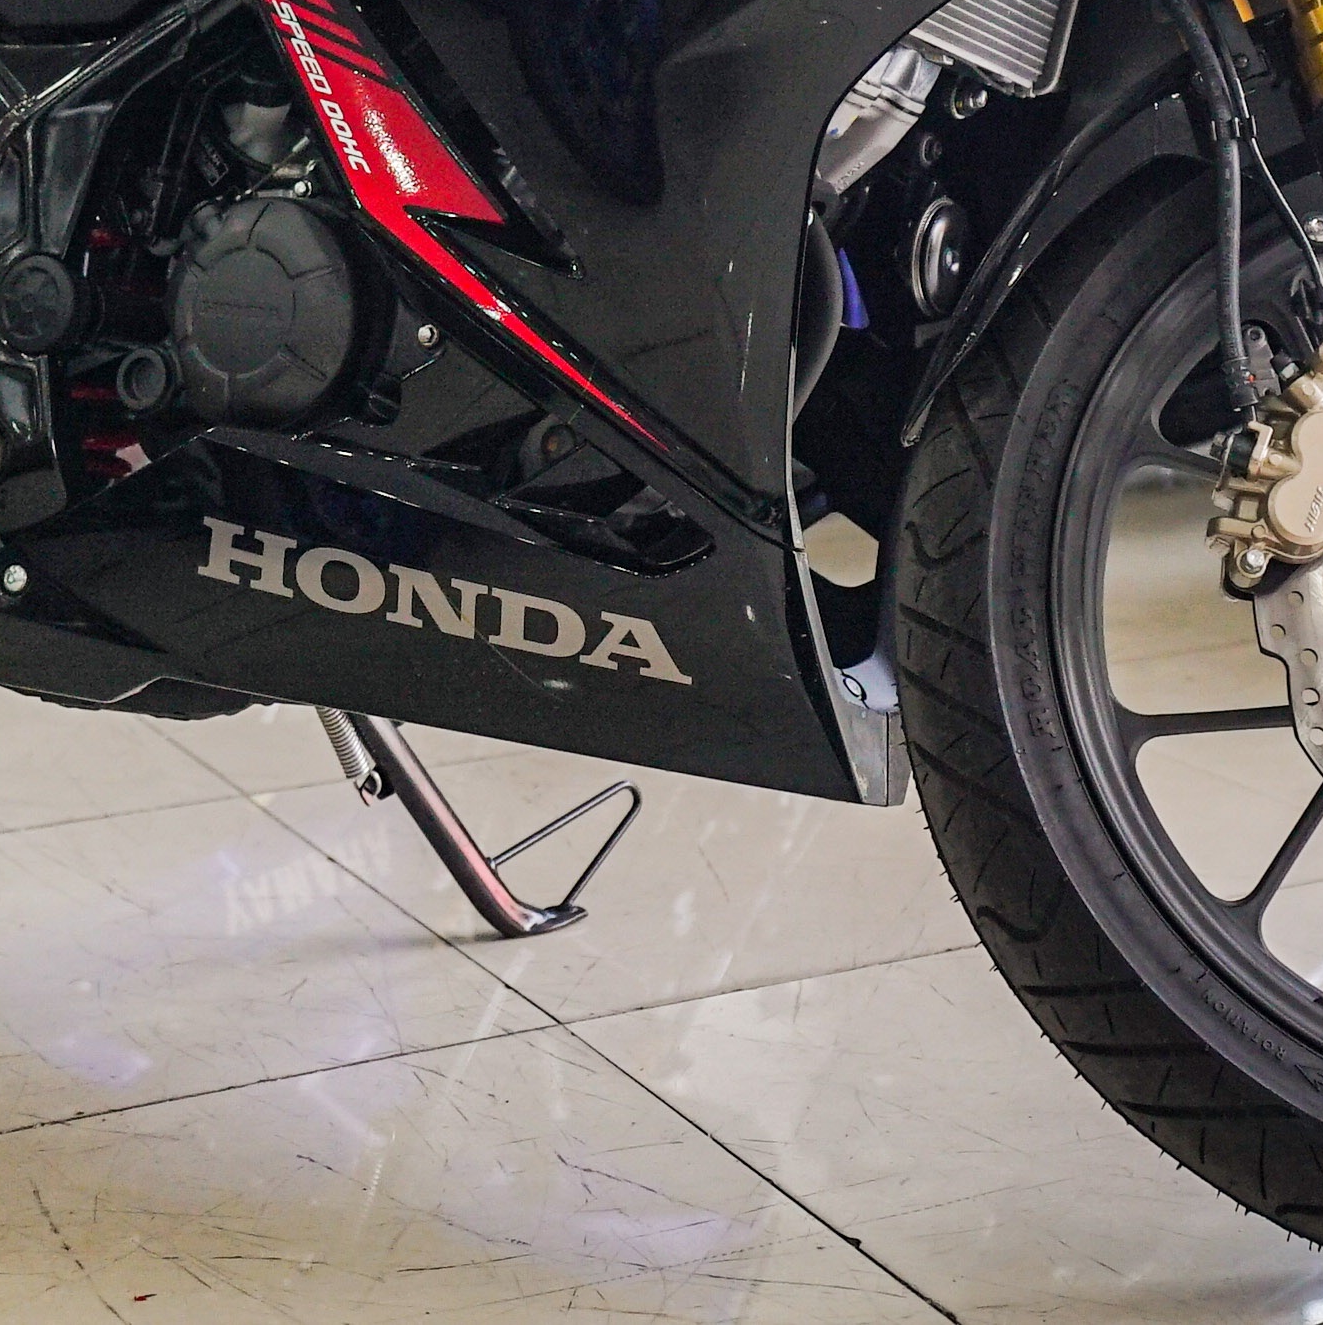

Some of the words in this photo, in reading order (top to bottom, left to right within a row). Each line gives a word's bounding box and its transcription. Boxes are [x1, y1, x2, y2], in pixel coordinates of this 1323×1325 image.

[271, 0, 332, 95] SPEED
[320, 98, 371, 174] DOHC
[196, 515, 693, 686] HONDA
